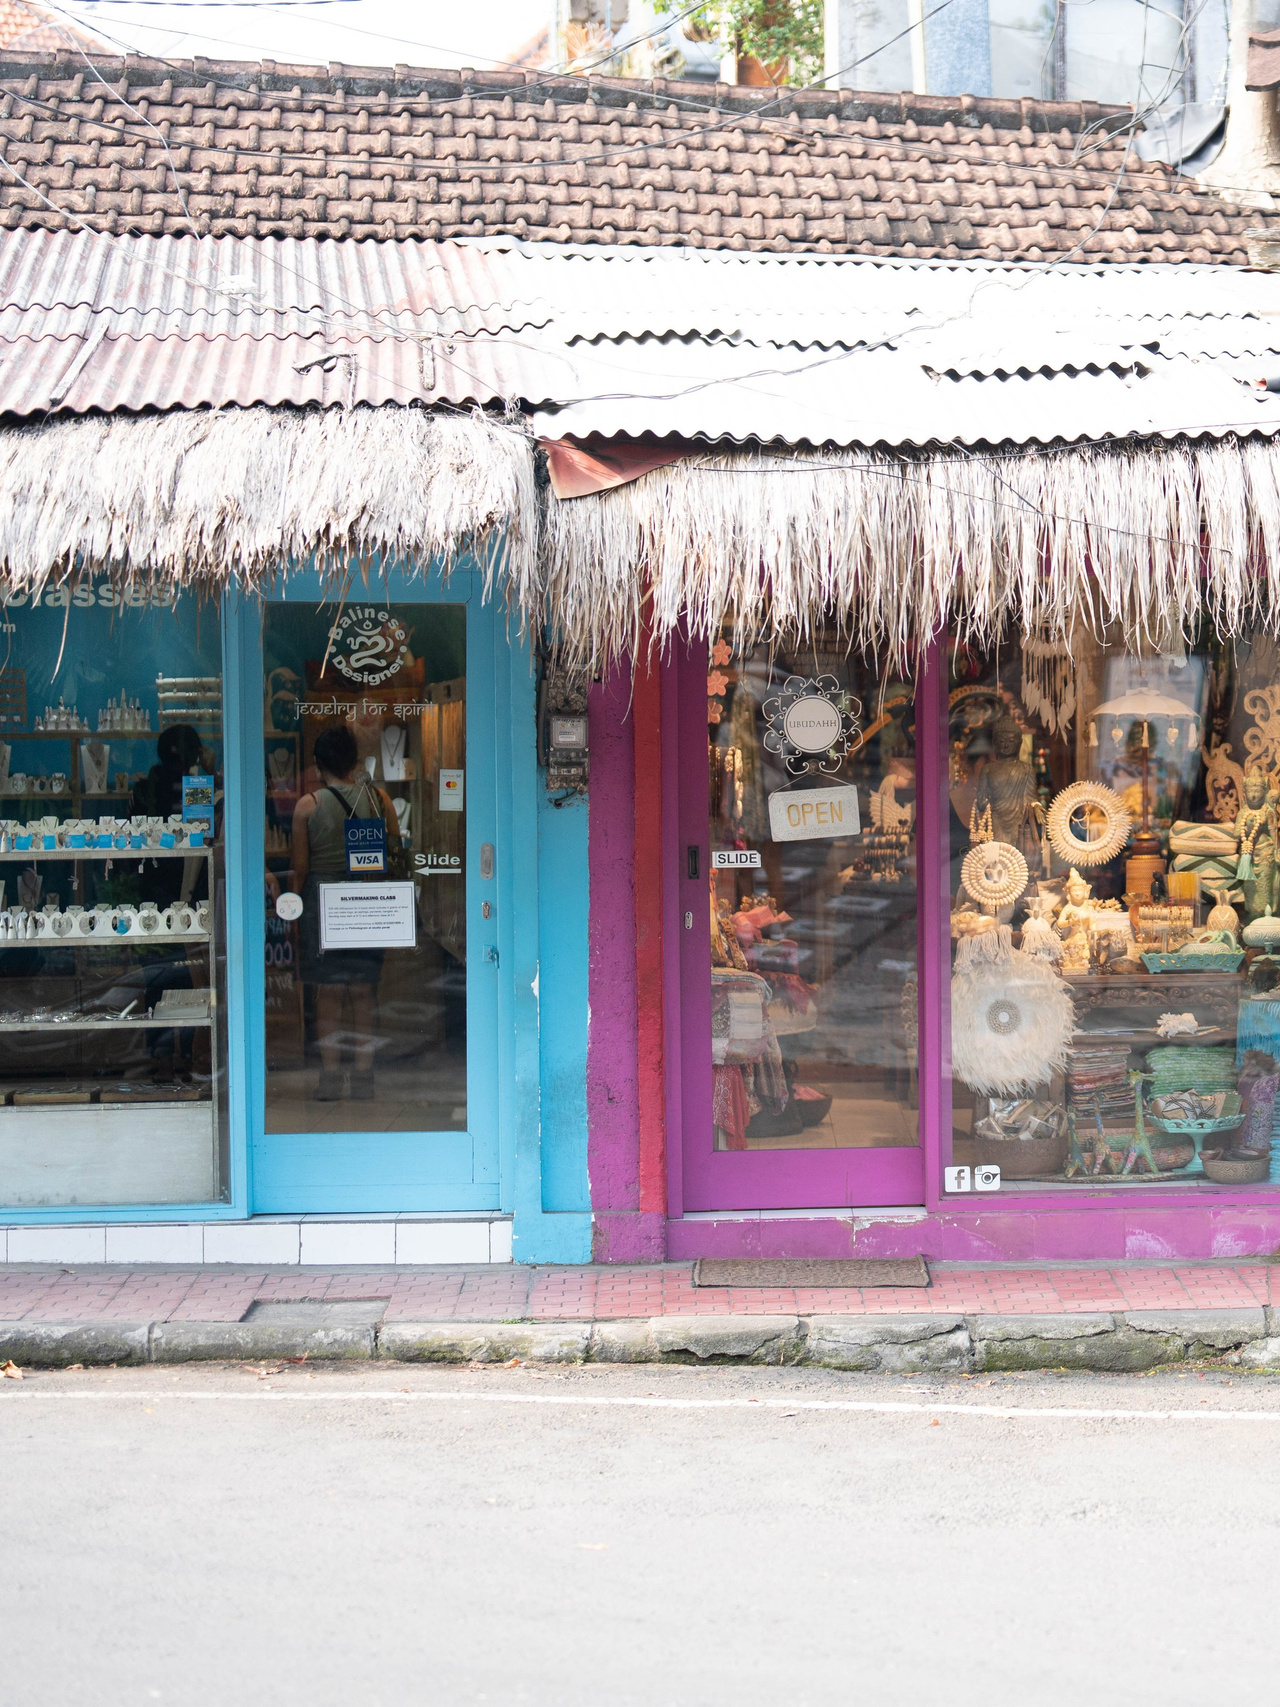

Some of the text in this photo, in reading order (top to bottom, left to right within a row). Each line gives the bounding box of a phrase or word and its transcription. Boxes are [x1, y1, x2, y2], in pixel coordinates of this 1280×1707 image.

[328, 606, 406, 641] Balinese
[332, 654, 404, 686] Designer
[294, 696, 438, 721] jewelry for spirit
[788, 719, 837, 728] UBUDAHH
[787, 800, 843, 828] OPEN
[348, 828, 383, 840] OPEN
[355, 855, 380, 864] VISA
[414, 853, 461, 865] Slide
[717, 853, 758, 864] SLIDE
